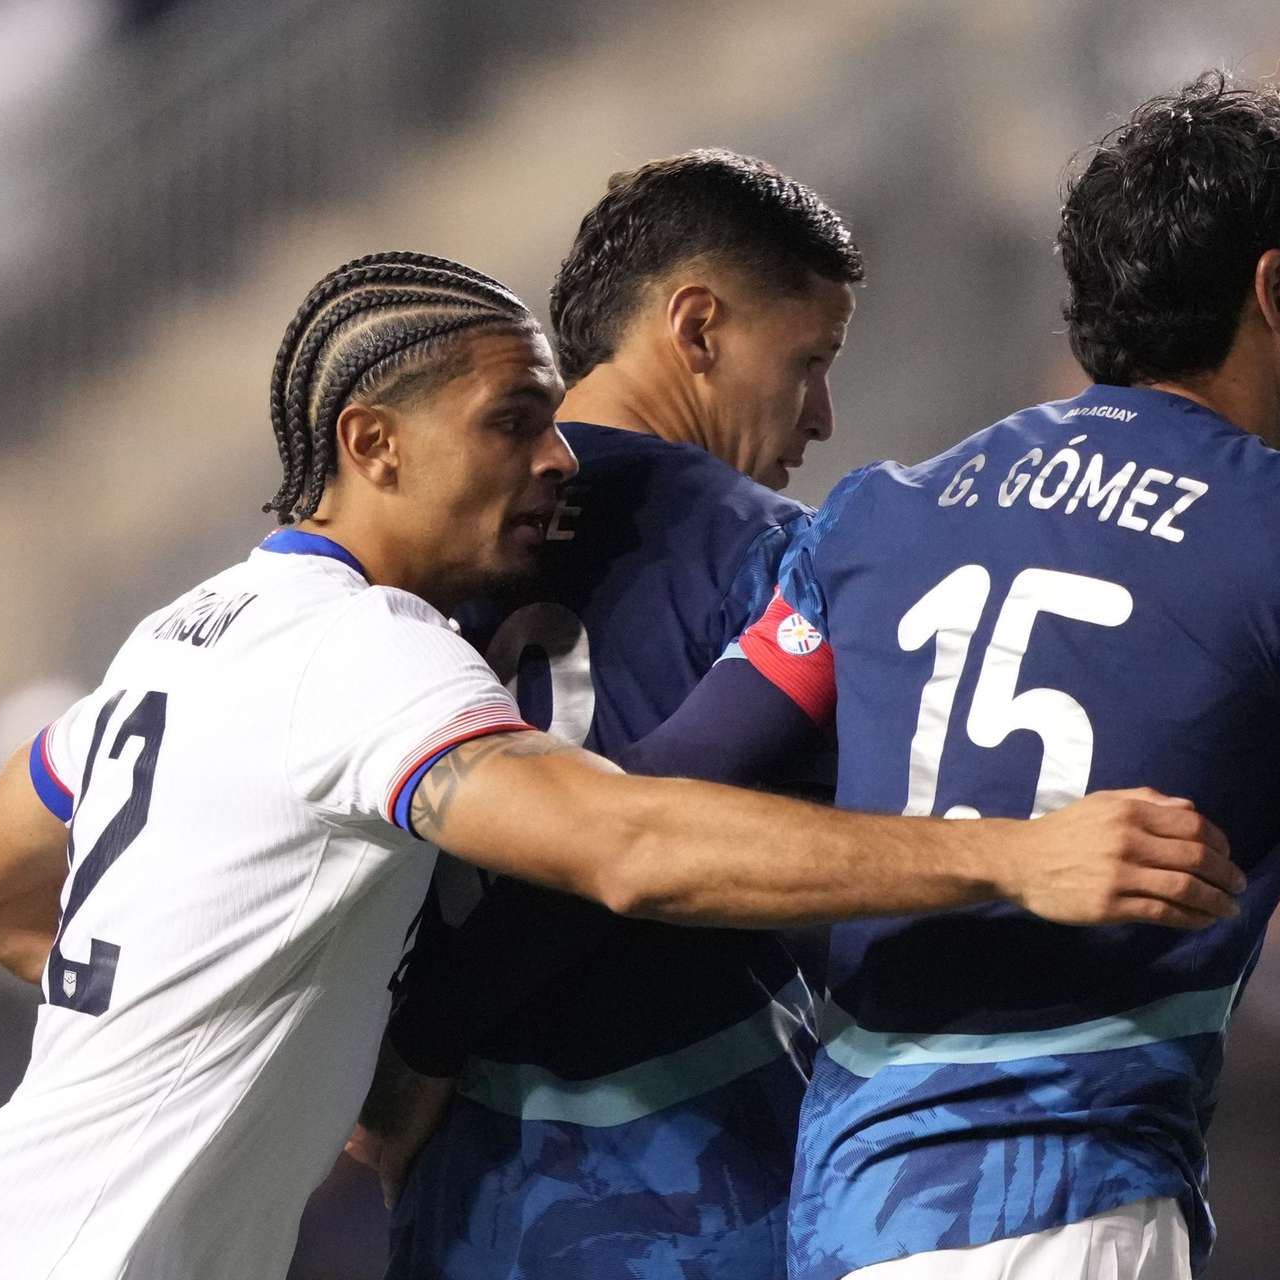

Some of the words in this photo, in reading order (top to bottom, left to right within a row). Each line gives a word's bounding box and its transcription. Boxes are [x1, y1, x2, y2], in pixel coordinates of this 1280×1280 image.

[937, 453, 987, 508] G.
[997, 434, 1209, 543] GÓMEZ
[897, 564, 1133, 820] 15
